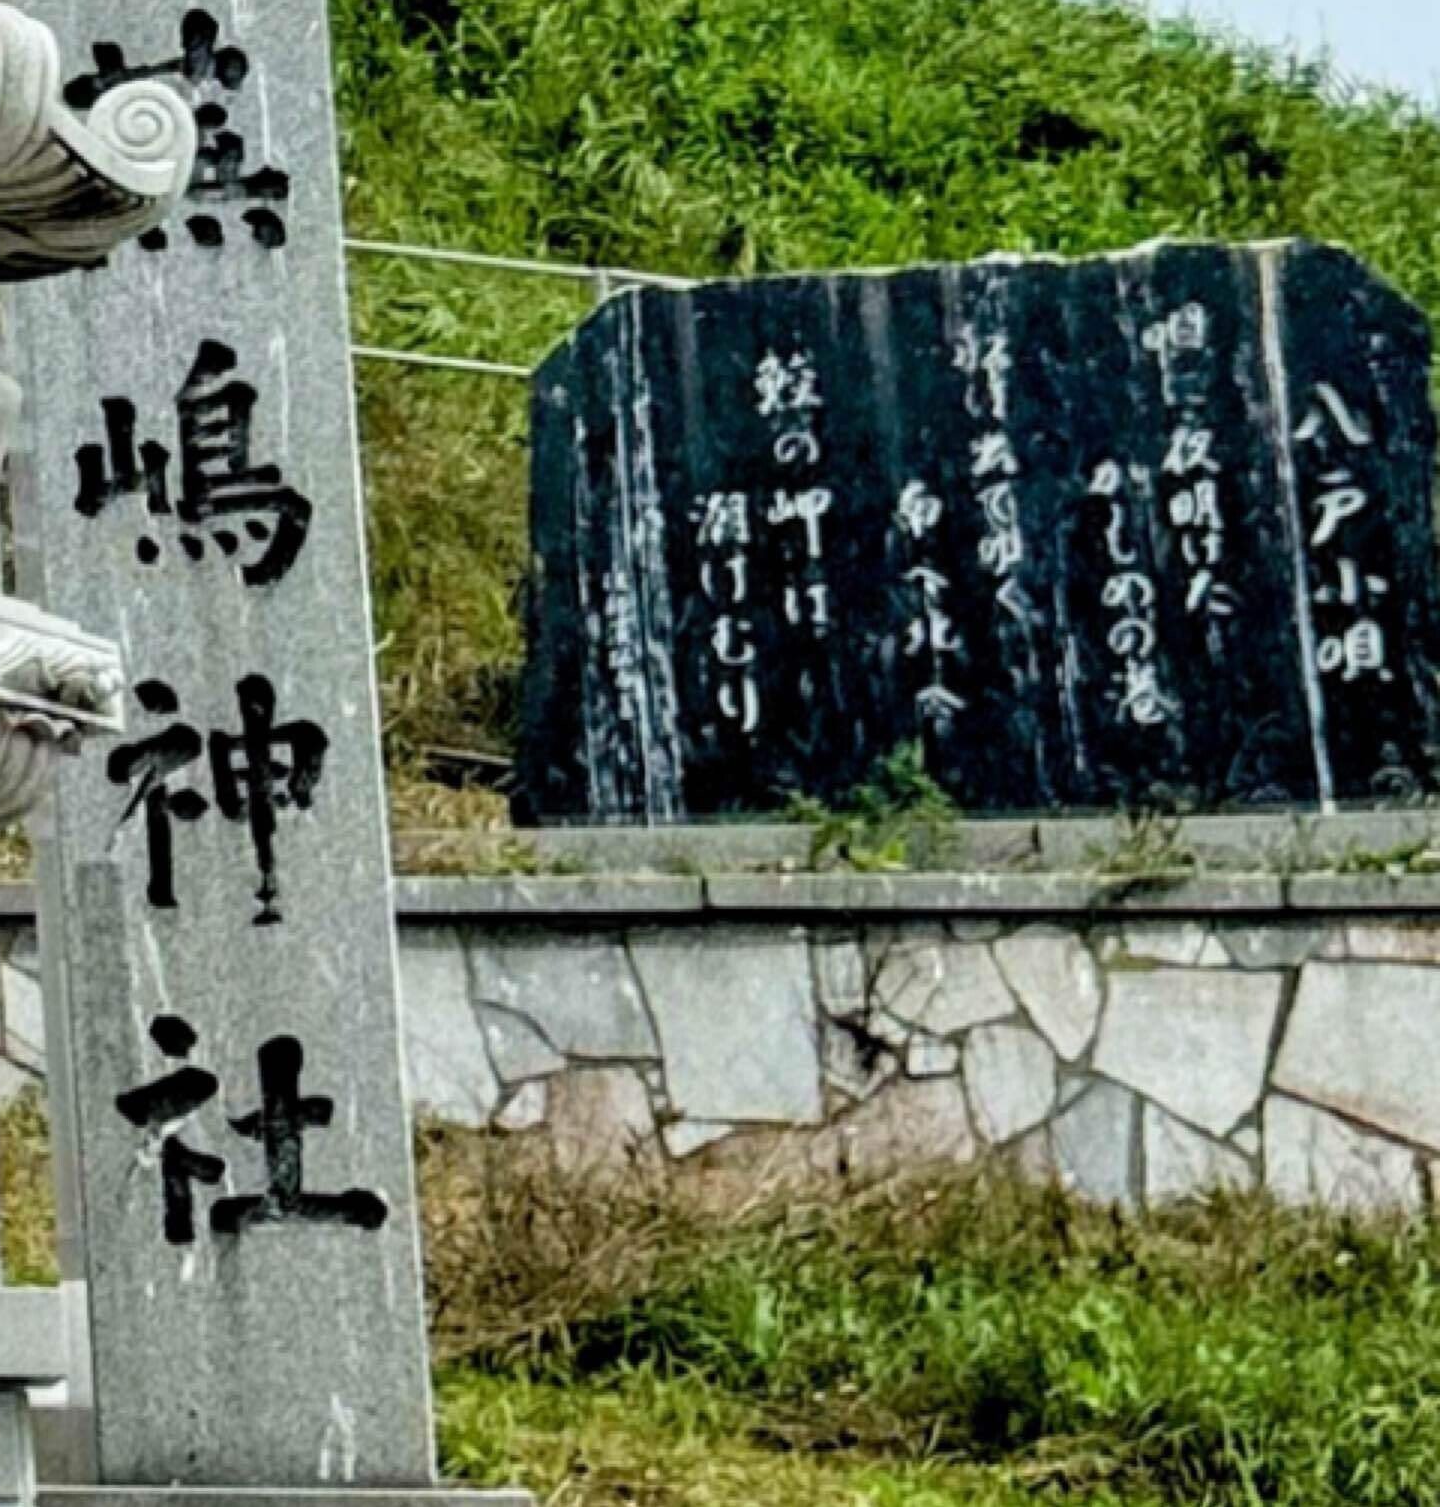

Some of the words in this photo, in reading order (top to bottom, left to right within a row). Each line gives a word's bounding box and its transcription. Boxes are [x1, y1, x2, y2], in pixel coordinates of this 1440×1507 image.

[688, 491, 760, 733] 潮けむり
[755, 351, 831, 636] 鮫の岬は
[1294, 383, 1393, 682] 八戸小唄
